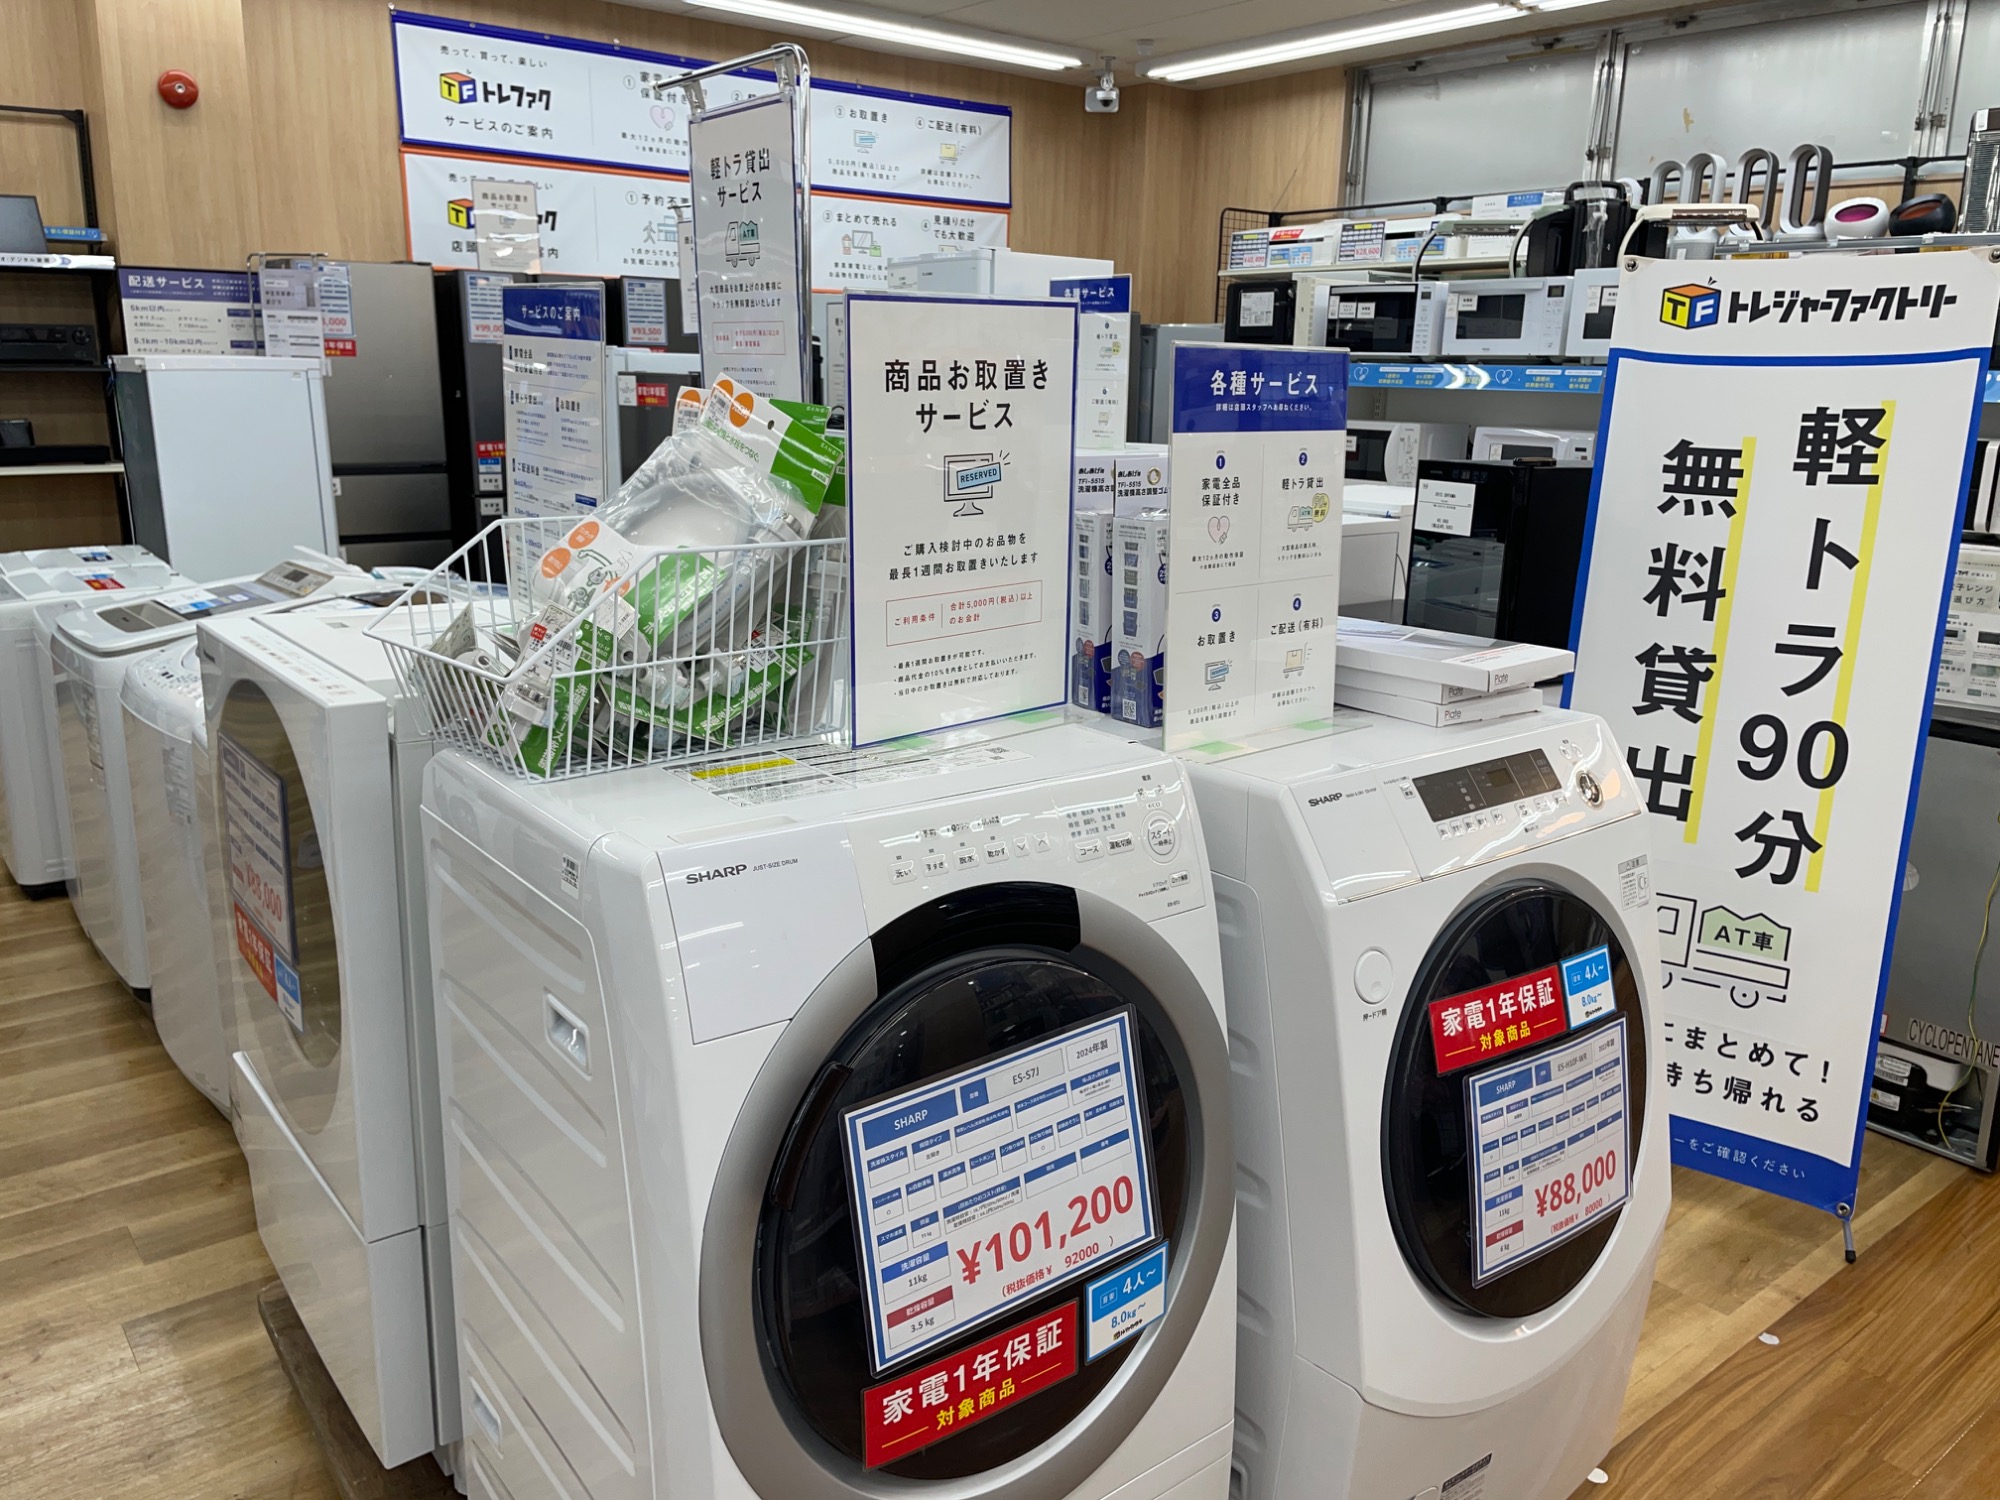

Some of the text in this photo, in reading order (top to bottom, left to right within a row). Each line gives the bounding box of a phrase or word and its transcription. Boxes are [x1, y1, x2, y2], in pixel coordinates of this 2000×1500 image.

[482, 81, 552, 111] トレファク
[849, 109, 888, 123] お取置き
[445, 115, 554, 140] サービスのご案内
[710, 148, 770, 180] 軽トラ貸出
[717, 180, 762, 208] サービス
[836, 212, 898, 227] まとめて売れる
[933, 215, 975, 229] 見積りだけ
[933, 229, 976, 242] でも大歓迎
[128, 275, 205, 289] 配送サービス
[1064, 286, 1115, 299] 各種サービス
[521, 304, 581, 322] サービスのご案内
[1728, 284, 1957, 324] トレジャーファクトリー
[884, 358, 1049, 393] 商品お取置き
[1211, 370, 1318, 396] 各種サービス
[915, 399, 1014, 434] サービス
[959, 467, 998, 485] RESERVED
[1202, 477, 1241, 490] 家電全品
[1282, 477, 1324, 491] 軽トラ貸出
[1202, 493, 1240, 507] 保証付き
[903, 532, 1027, 558] ご購入検討中のお品物を
[889, 551, 1039, 581] 最長1週間お取置きいたします
[1953, 583, 1994, 594] 子レンジ
[894, 613, 936, 627] ご利用条件
[949, 613, 981, 625] のお会計
[1197, 631, 1236, 647] お取置き
[1626, 439, 1745, 822] 無料貸出
[1734, 406, 1887, 885] 軽トラ90分
[1495, 673, 1508, 685] Plate
[1445, 709, 1461, 719] Plate
[1308, 792, 1343, 807] SHARP
[987, 847, 1005, 858] 乾かす
[1080, 845, 1099, 856] コース
[959, 855, 974, 865] 脱水
[686, 858, 798, 885] SHARP JUST-SIZE DRUM
[1713, 926, 1774, 951] AT車
[1441, 976, 1556, 1037] 家電1年保証
[1480, 1020, 1531, 1053] 対象商品
[1909, 1018, 2000, 1068] CYCLOPENTANE
[894, 1108, 929, 1131] SHARP
[1012, 1066, 1040, 1085] ES-S7J
[1075, 1038, 1110, 1060] 2024年製
[1496, 1079, 1516, 1095] SHARP
[1534, 1149, 1616, 1218] ¥88,000
[1499, 1206, 1510, 1217] 11kg
[956, 1175, 1134, 1285] ¥101,200
[900, 1253, 931, 1272] 洗濯容量
[1064, 1242, 1100, 1268] 92000
[908, 1272, 928, 1288] 11kg
[906, 1298, 935, 1316] 乾燥容量
[910, 1319, 924, 1333] 3.5
[881, 1316, 1063, 1426] 家電1年保証
[936, 1377, 1015, 1431] 対象商品
